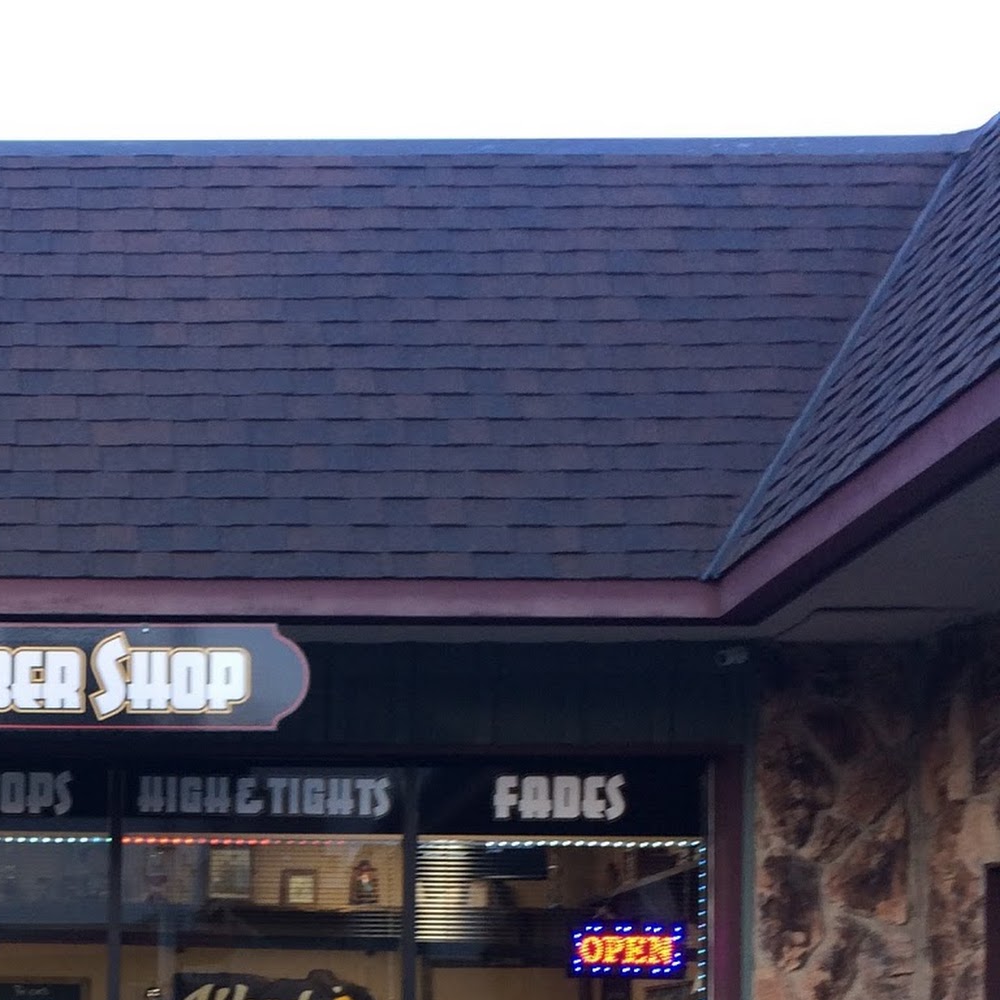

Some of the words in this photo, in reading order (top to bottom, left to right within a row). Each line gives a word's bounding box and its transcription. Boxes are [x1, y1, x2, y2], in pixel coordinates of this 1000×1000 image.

[88, 631, 252, 721] SHOP
[137, 775, 231, 813] HIGH
[266, 776, 391, 818] TIGHTS
[493, 773, 626, 821] FADES
[579, 935, 673, 966] OPEN
